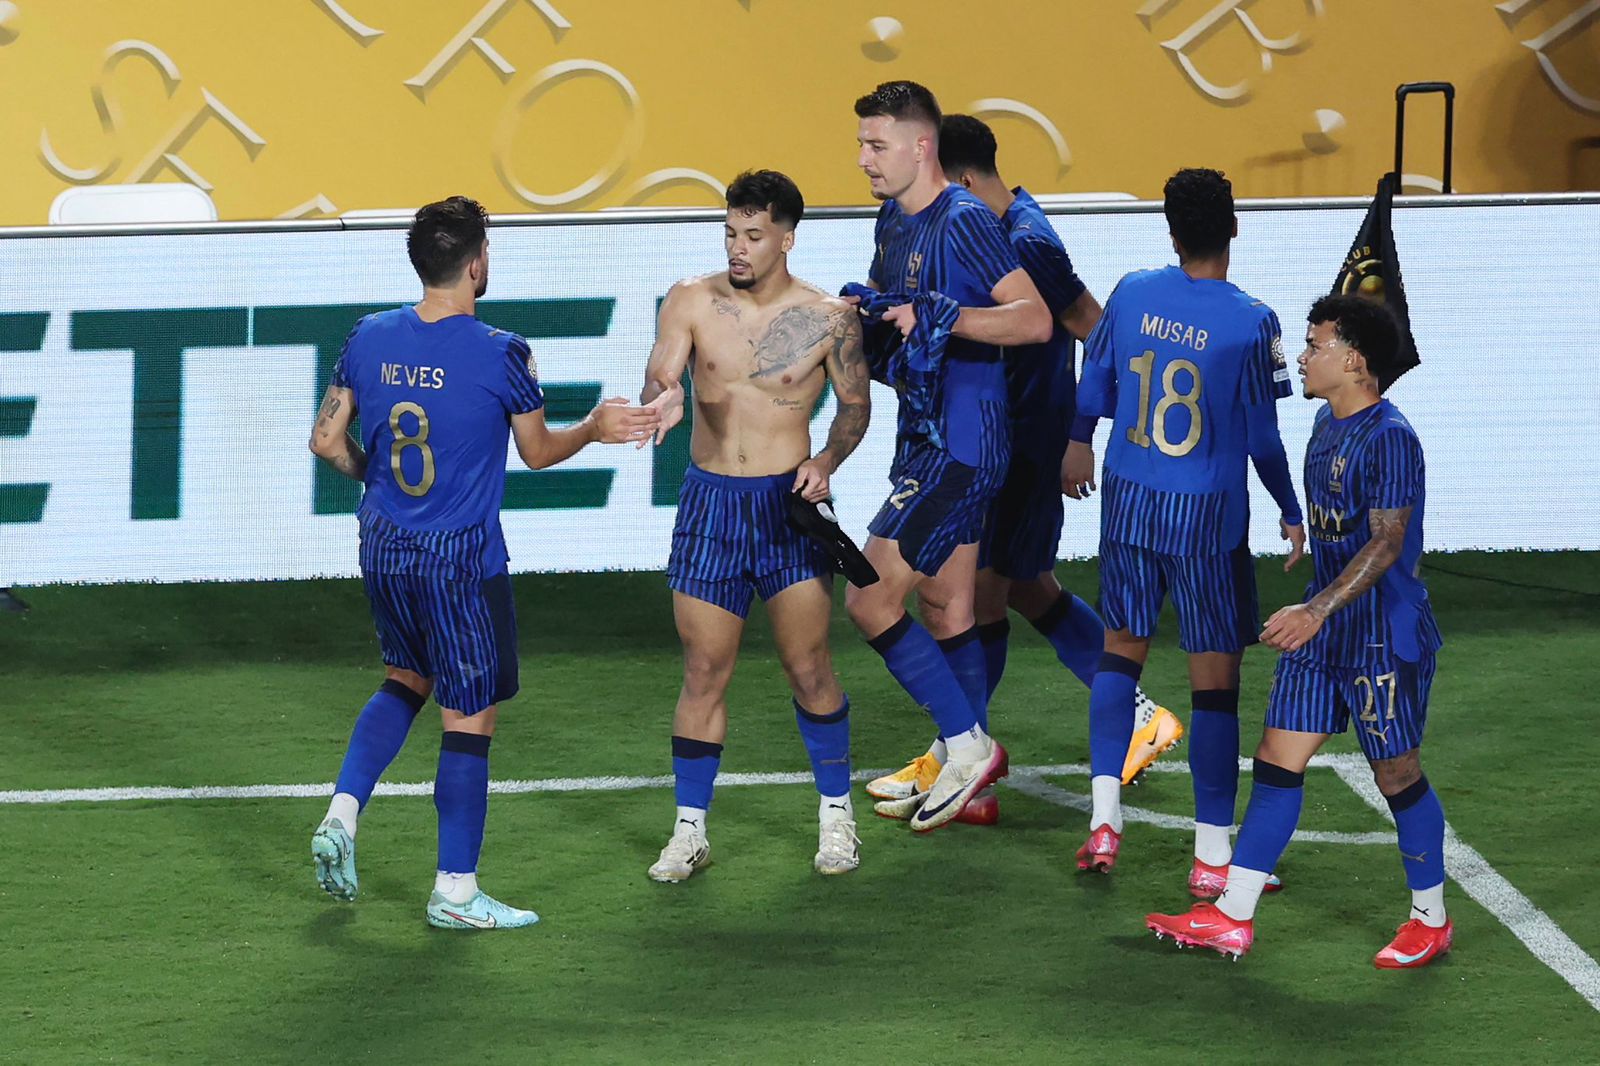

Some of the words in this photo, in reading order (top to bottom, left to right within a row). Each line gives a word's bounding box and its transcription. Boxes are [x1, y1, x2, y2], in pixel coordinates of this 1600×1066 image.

[1140, 312, 1209, 351] MUSAB
[0, 296, 837, 523] TTE
[380, 362, 446, 390] NEVES
[1126, 349, 1203, 458] 18
[388, 400, 437, 498] 8
[1353, 671, 1397, 722] 27
